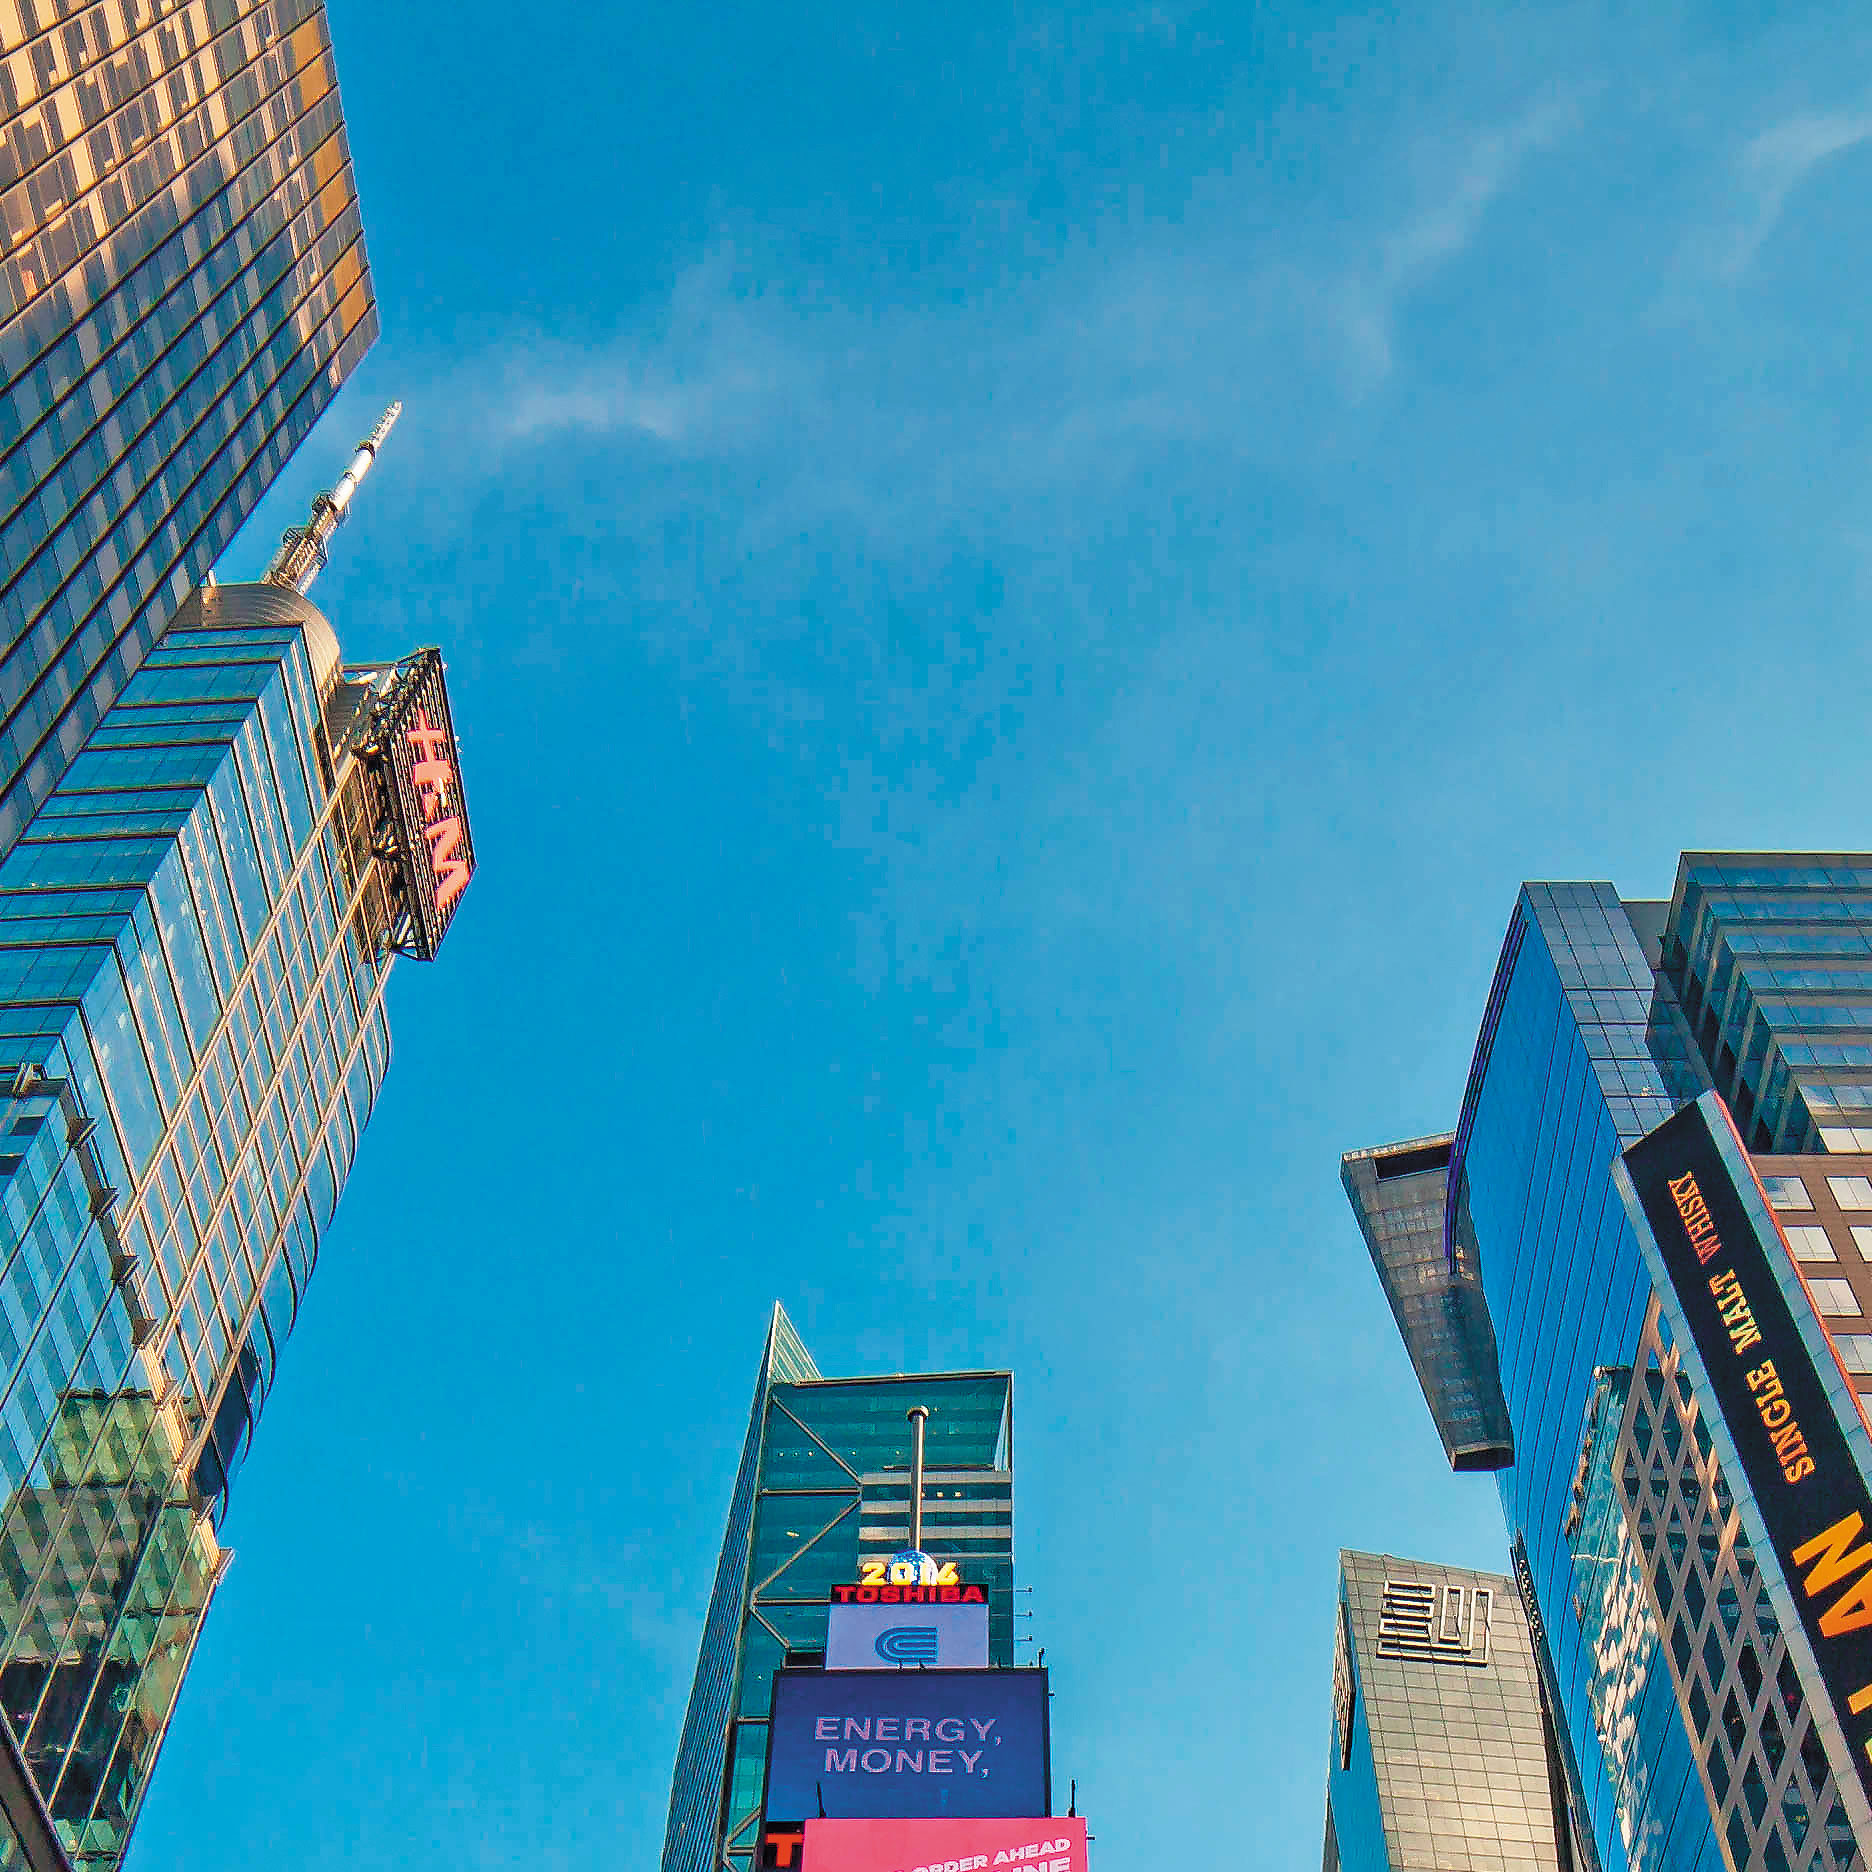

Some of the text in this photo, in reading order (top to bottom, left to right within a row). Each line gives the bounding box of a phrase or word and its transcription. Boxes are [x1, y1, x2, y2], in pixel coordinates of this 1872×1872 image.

[1669, 1171, 1815, 1484] SINGLE MALT WHISKY
[860, 1561, 960, 1586] 2016
[836, 1586, 985, 1603] TOSHIBA
[815, 1717, 1003, 1745] ENERGY,
[824, 1748, 990, 1778] MONEY,
[993, 1838, 1071, 1866] AHEAD
